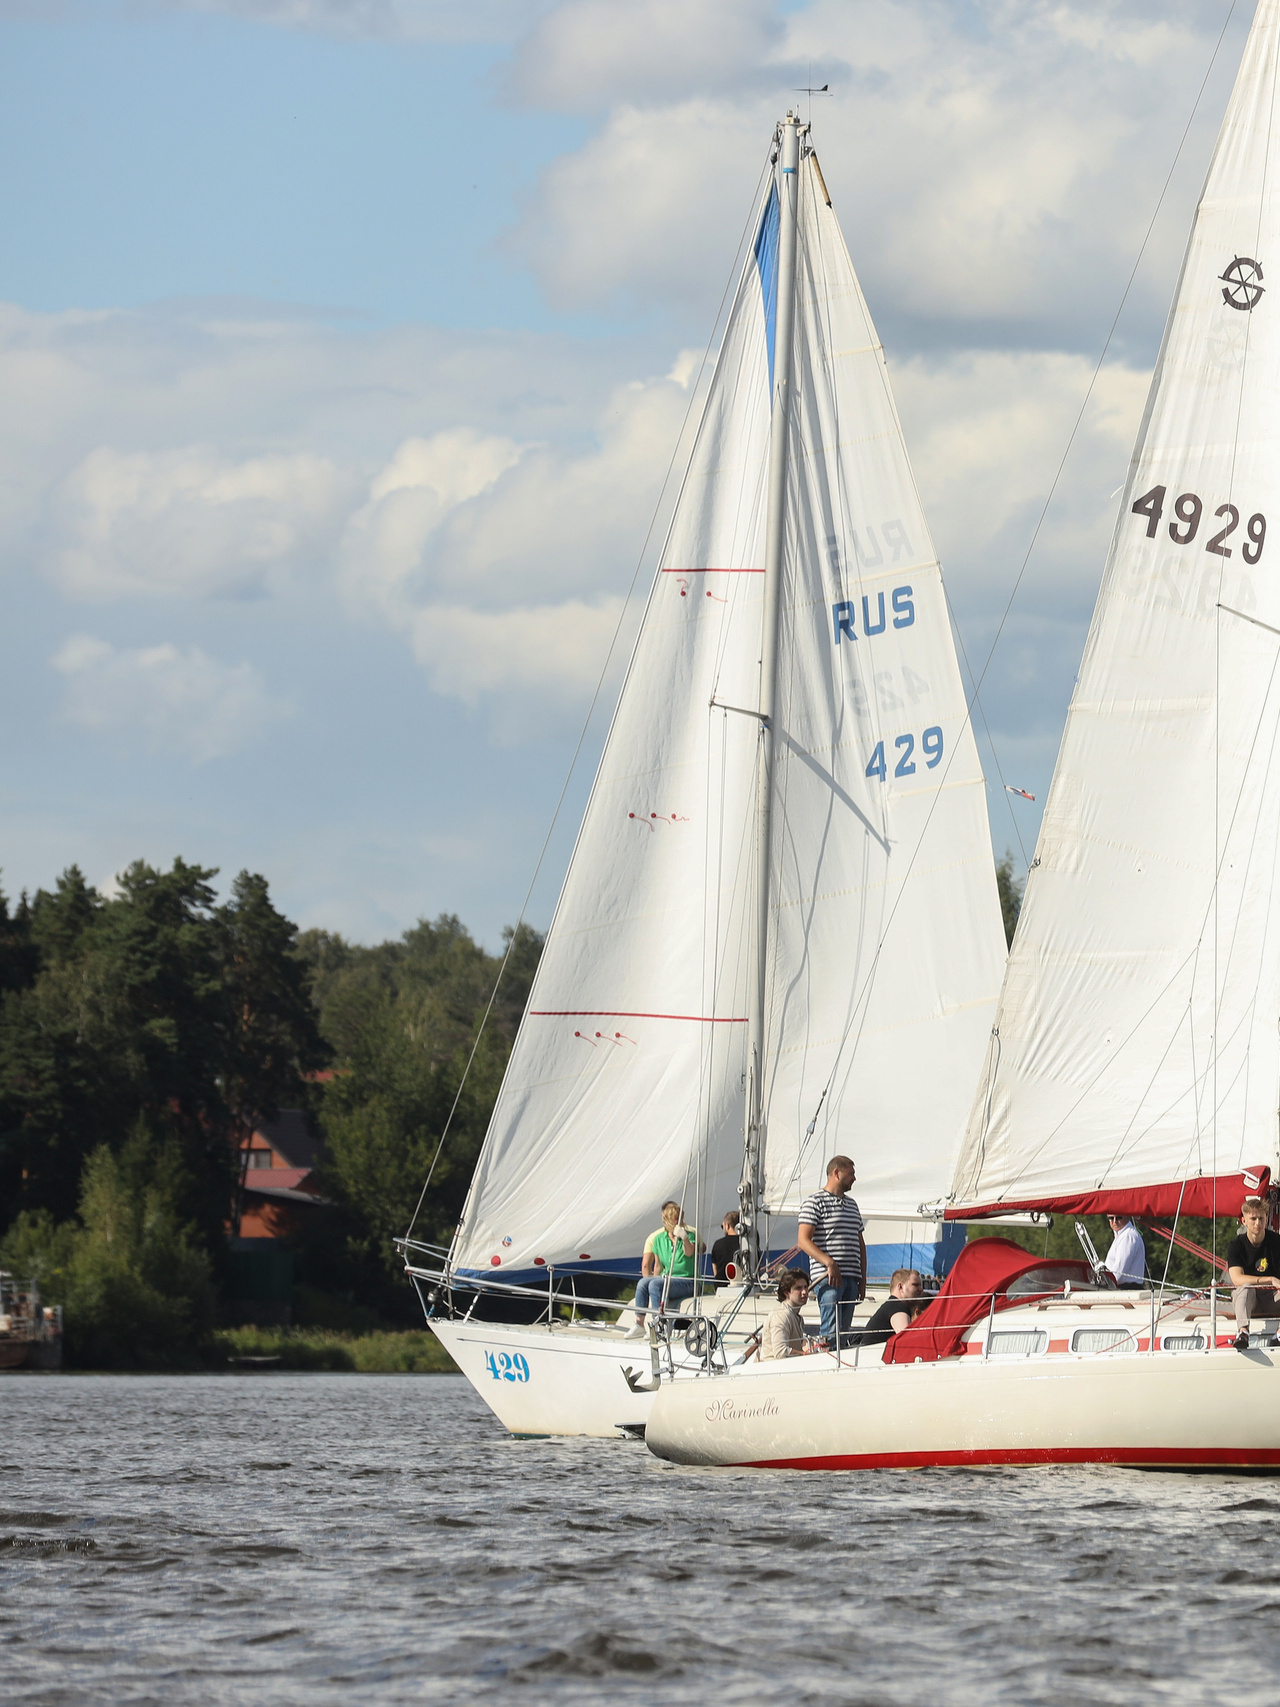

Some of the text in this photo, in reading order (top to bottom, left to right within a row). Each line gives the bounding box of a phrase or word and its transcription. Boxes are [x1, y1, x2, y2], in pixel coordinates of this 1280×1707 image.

[1131, 484, 1266, 565] 4929
[831, 585, 915, 645] RUS
[865, 725, 944, 782] 429
[484, 1350, 530, 1383] 429
[705, 1397, 780, 1422] Marinella
